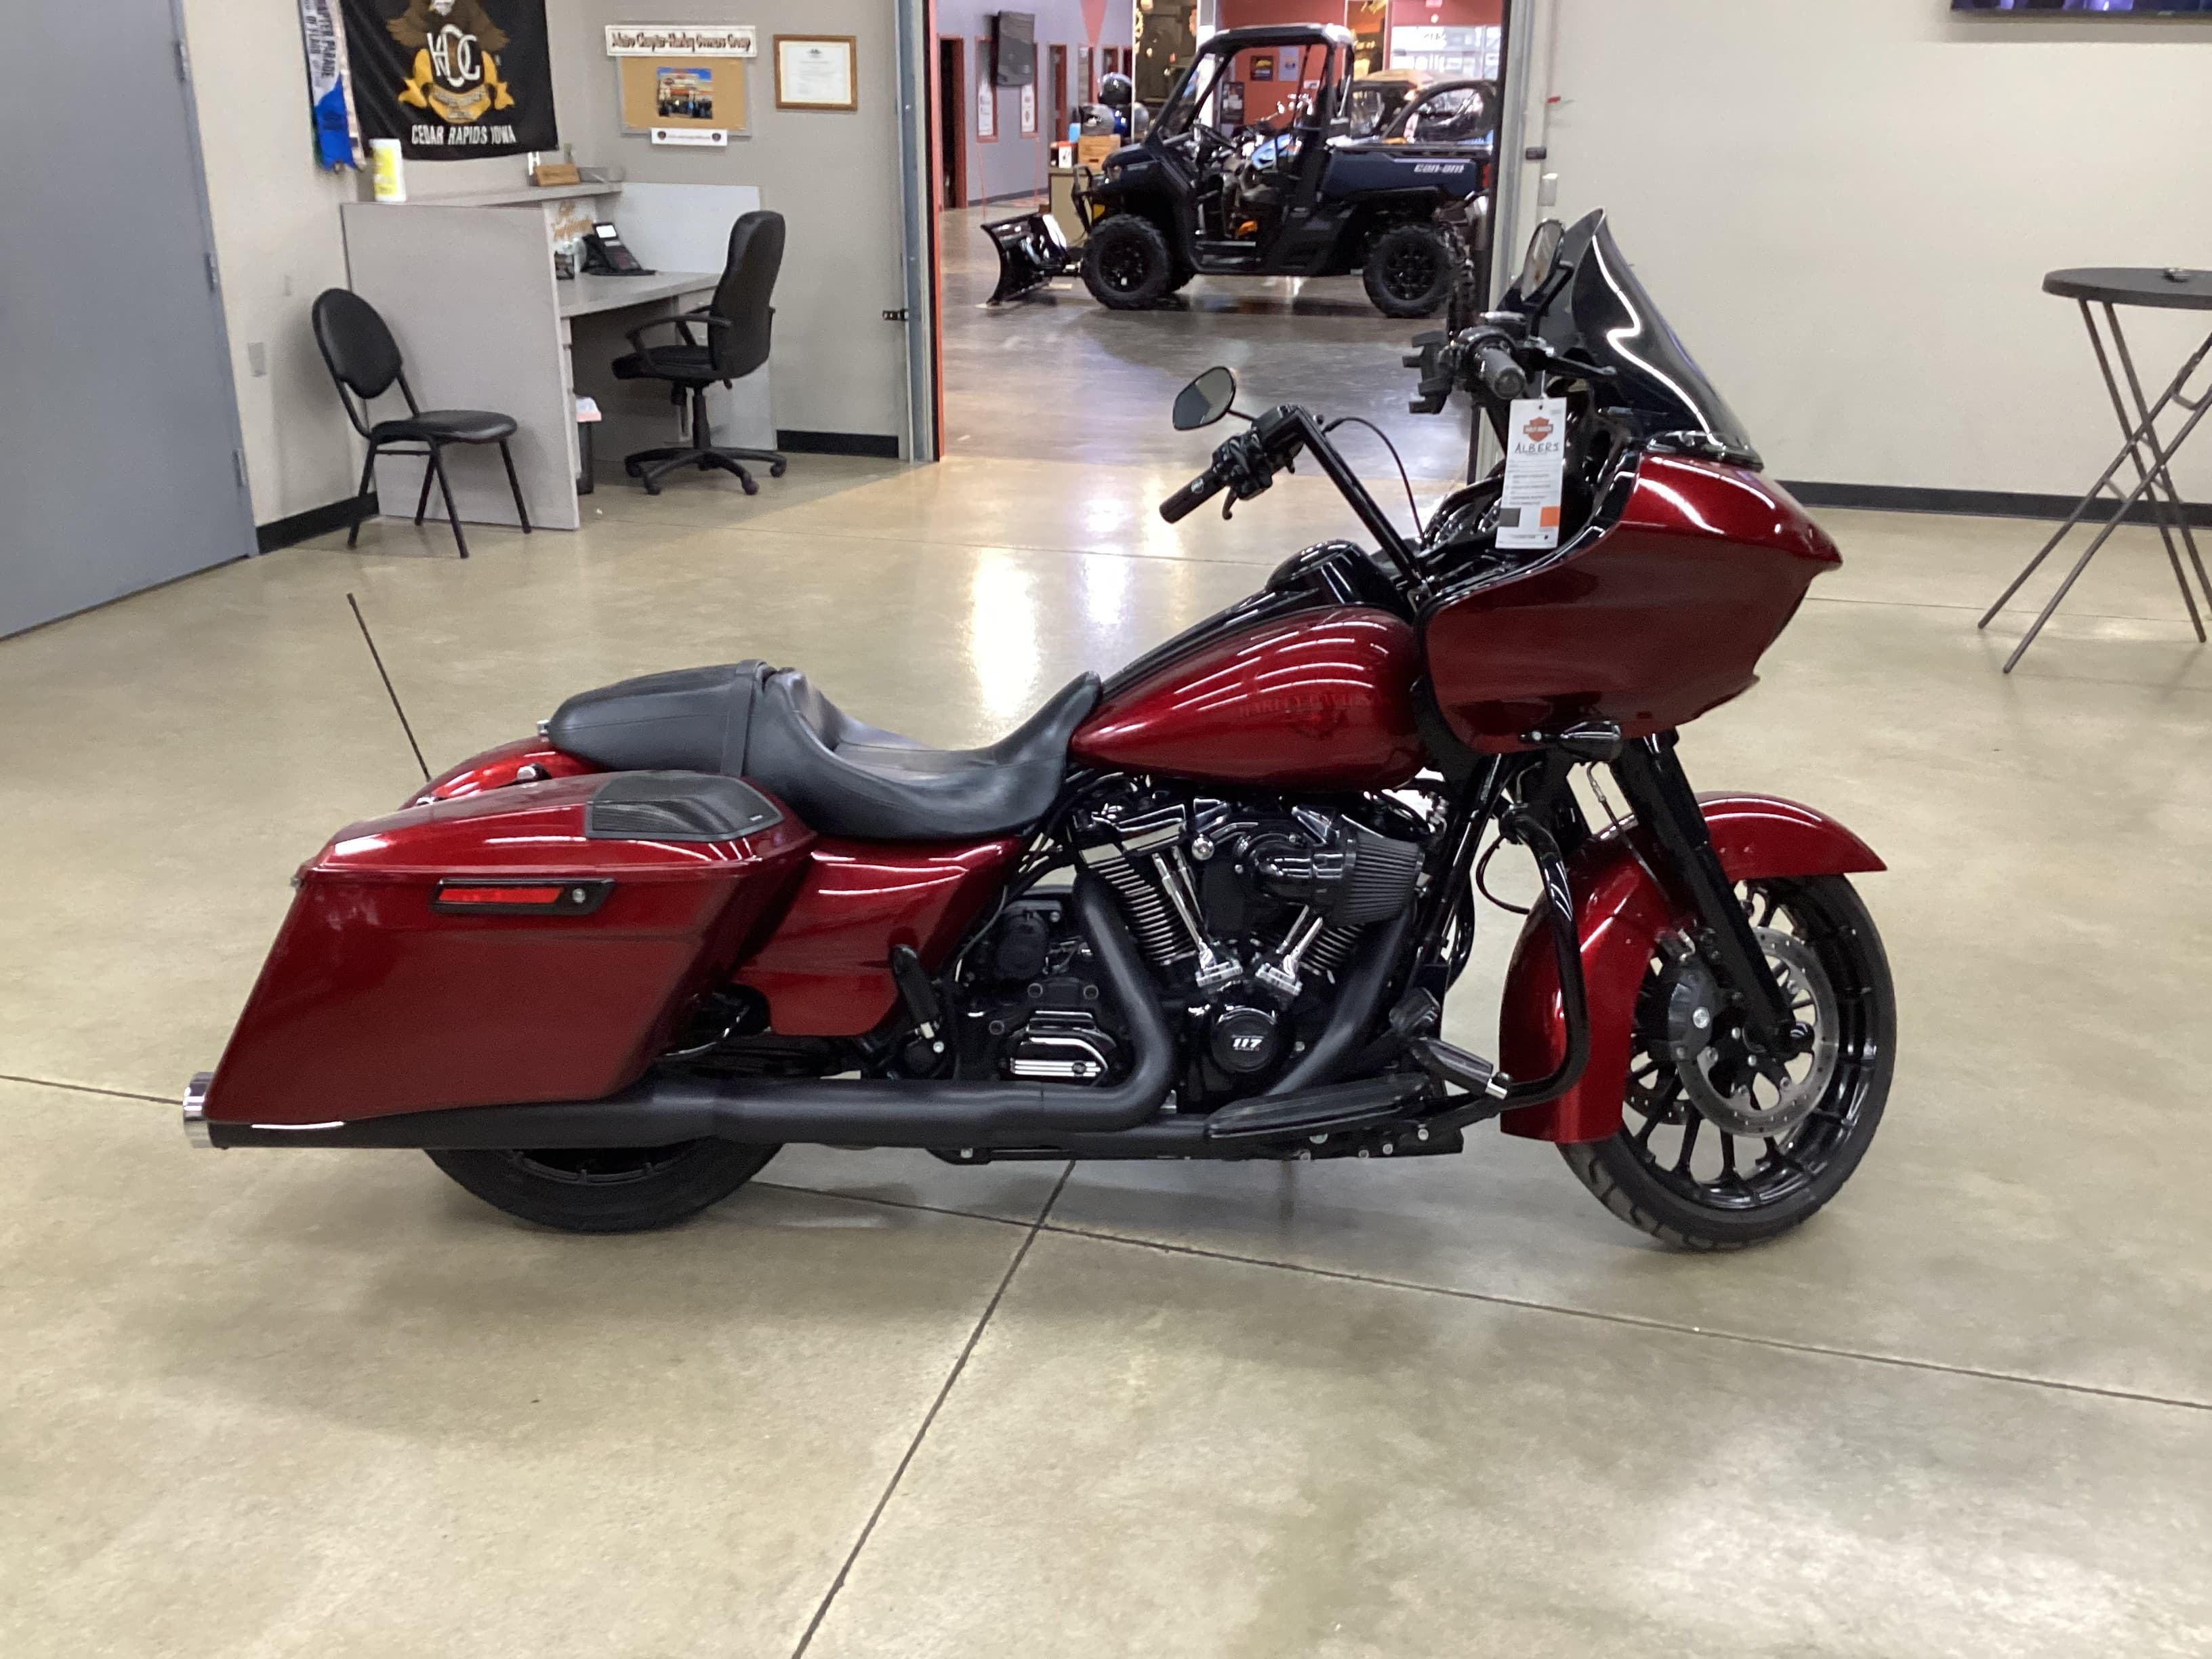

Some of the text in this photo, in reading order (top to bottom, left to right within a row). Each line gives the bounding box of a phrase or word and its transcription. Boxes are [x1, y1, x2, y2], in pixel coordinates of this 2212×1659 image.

[411, 125, 516, 144] CEDAR RAPIDS IOWA
[1514, 442, 1560, 455] ALBERS
[1233, 1038, 1262, 1048] 117
